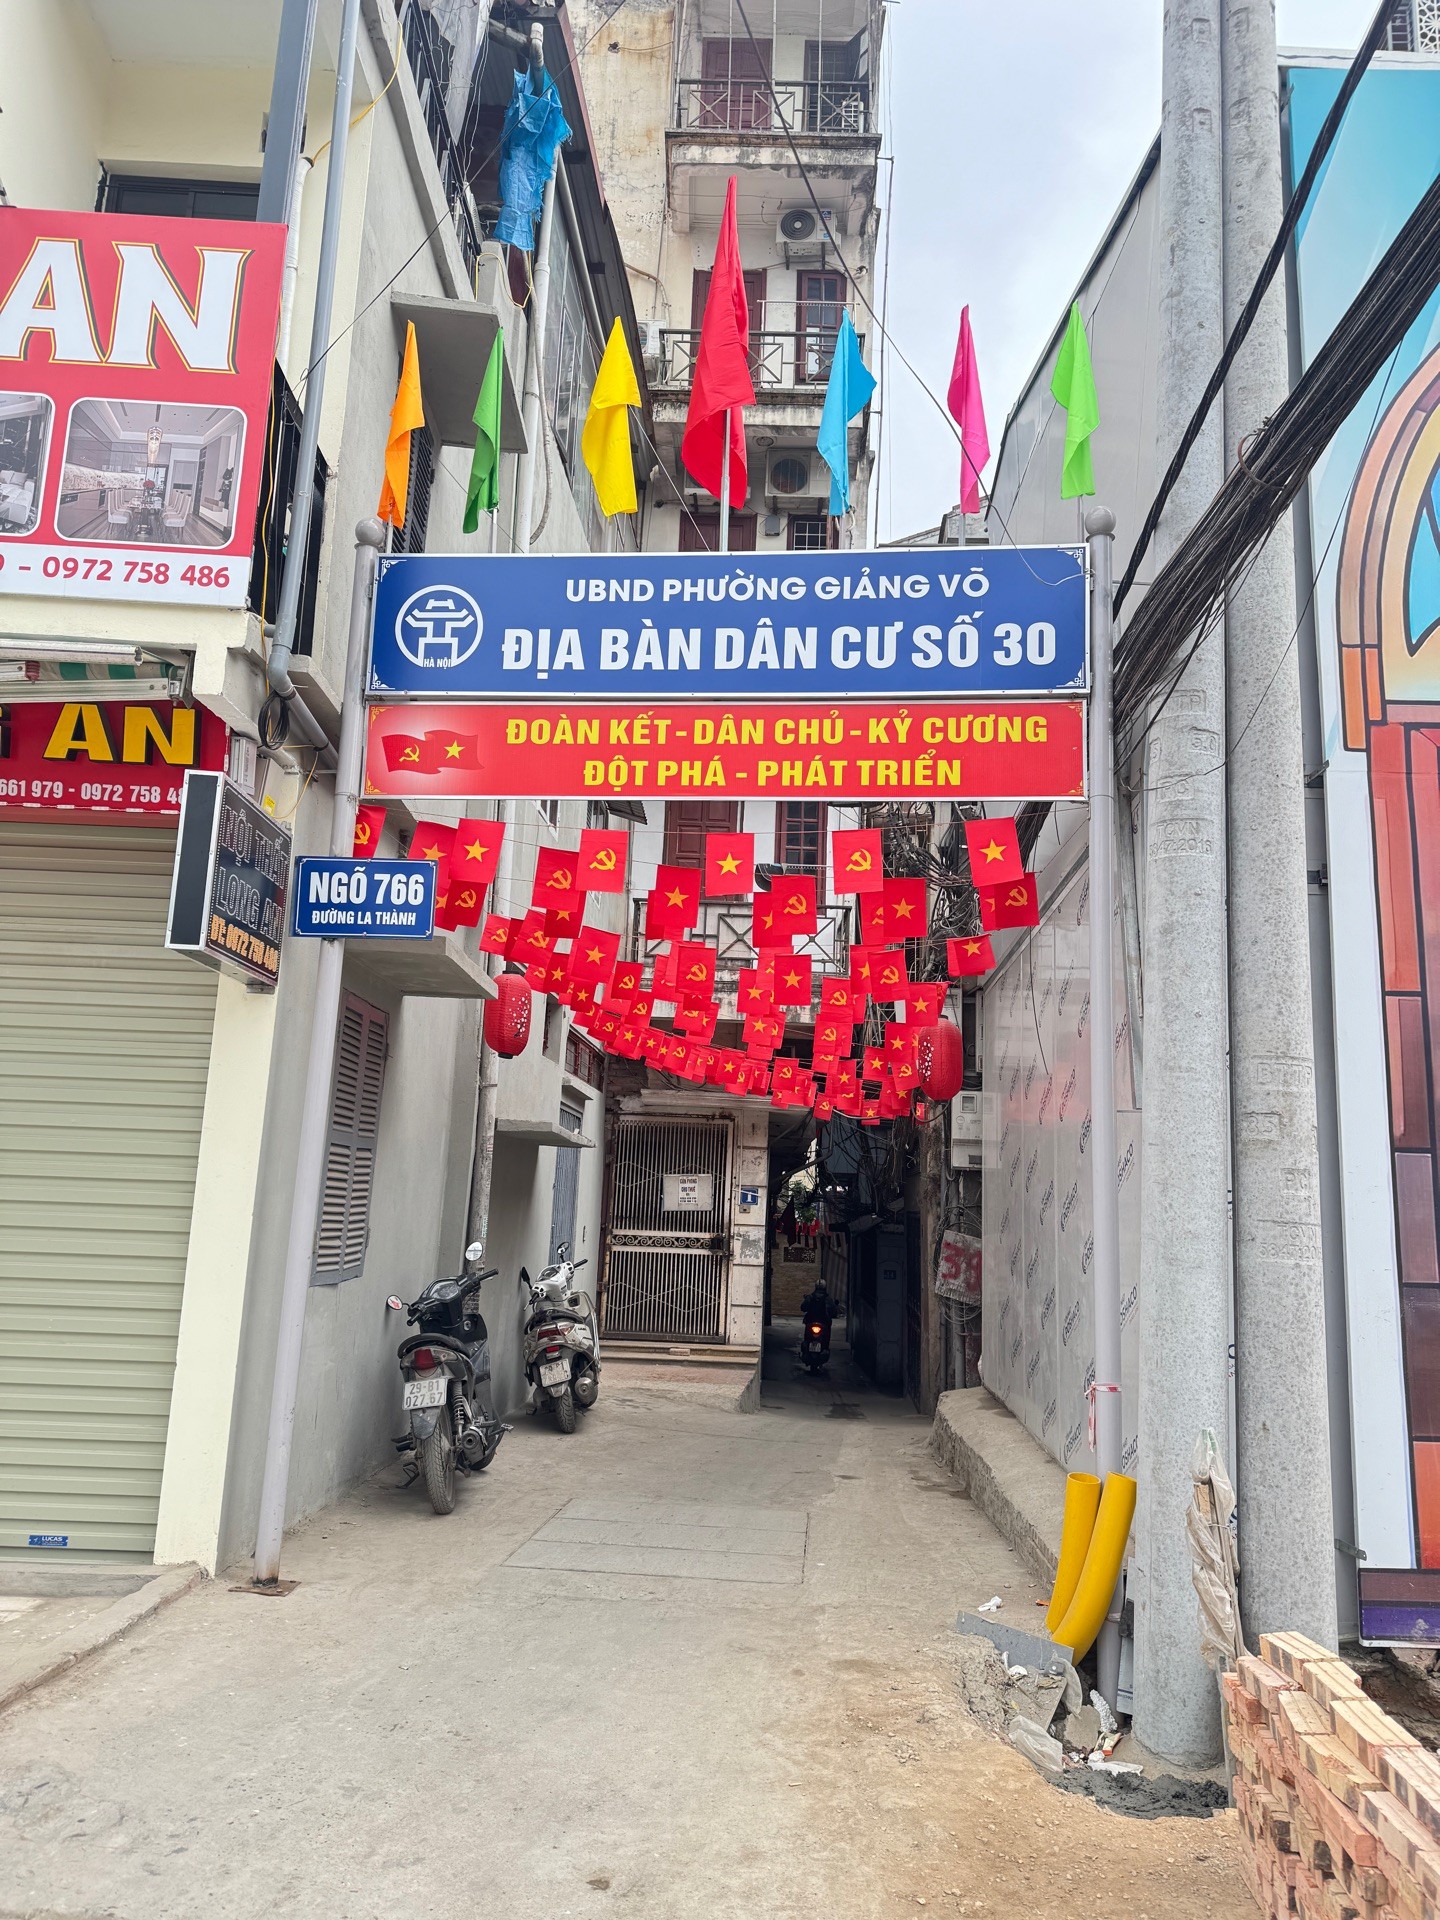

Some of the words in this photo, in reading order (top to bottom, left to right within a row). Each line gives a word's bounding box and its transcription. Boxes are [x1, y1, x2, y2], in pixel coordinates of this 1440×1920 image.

[0, 236, 251, 374] AN
[42, 556, 113, 581] 0972
[123, 560, 170, 585] 758
[180, 564, 230, 588] 486
[566, 578, 655, 602] UBND
[662, 568, 806, 602] PHƯỜNG
[814, 567, 930, 600] GIẢNG
[937, 567, 990, 598] VÕ
[501, 628, 585, 680] ĐỊA
[599, 618, 702, 671] BÀN
[714, 617, 818, 670] DÂN
[830, 621, 904, 669] CƯ
[911, 610, 985, 669] SỐ
[993, 621, 1056, 666] 30
[423, 656, 435, 668] HÀ
[436, 656, 451, 670] NỘI
[43, 702, 198, 766] AN
[506, 713, 600, 745] ĐOÀN
[609, 711, 672, 745] KẾT
[693, 713, 765, 745] DÂN
[774, 709, 844, 745] CHỦ
[868, 708, 913, 744] KỶ
[922, 713, 1048, 744] CƯƠNG
[583, 754, 649, 792] ĐỘT
[657, 755, 727, 787] PHÁ
[757, 754, 848, 787] PHÁT
[856, 748, 962, 786] TRIỂN
[31, 780, 64, 799] 979
[80, 782, 124, 802] 0972
[129, 785, 161, 804] 758
[308, 866, 368, 905] NGÕ
[373, 873, 425, 906] 766
[215, 865, 261, 931] LONG
[260, 897, 283, 944] AN
[311, 907, 355, 925] ĐƯỜNG
[357, 911, 372, 925] LA
[375, 908, 417, 926] THÀNH
[746, 1191, 753, 1202] 1
[405, 1391, 443, 1409] 027.67
[409, 1379, 441, 1396] 29-B1
